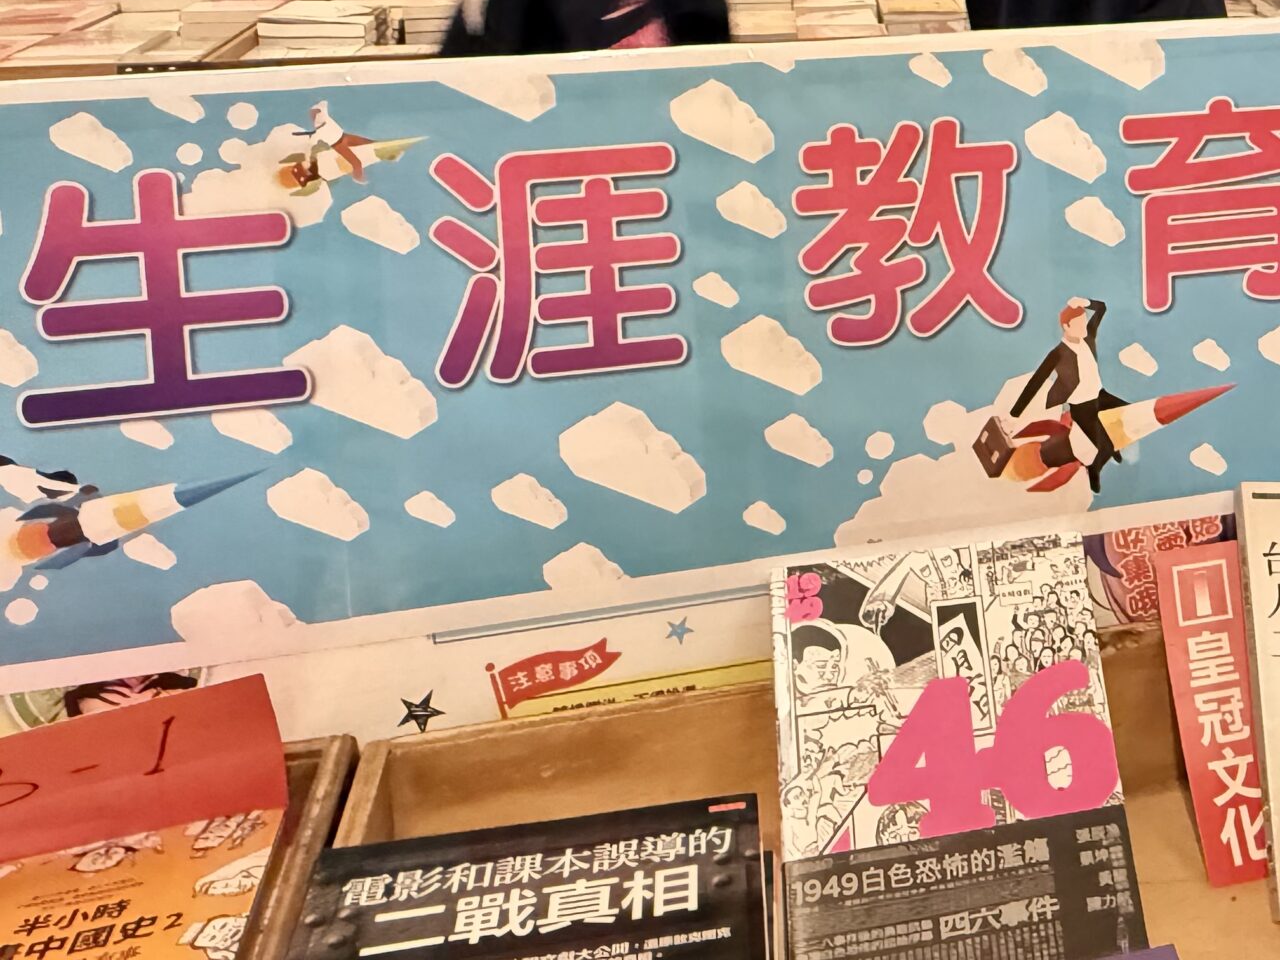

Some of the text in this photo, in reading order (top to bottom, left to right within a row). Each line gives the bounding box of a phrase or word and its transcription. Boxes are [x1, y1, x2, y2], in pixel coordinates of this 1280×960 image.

[867, 659, 1120, 840] 46
[1186, 629, 1267, 867] 皇冠文化
[342, 825, 733, 907] 電影和課本誤導的
[358, 863, 700, 958] 二戰真相
[13, 899, 132, 937] 半小時
